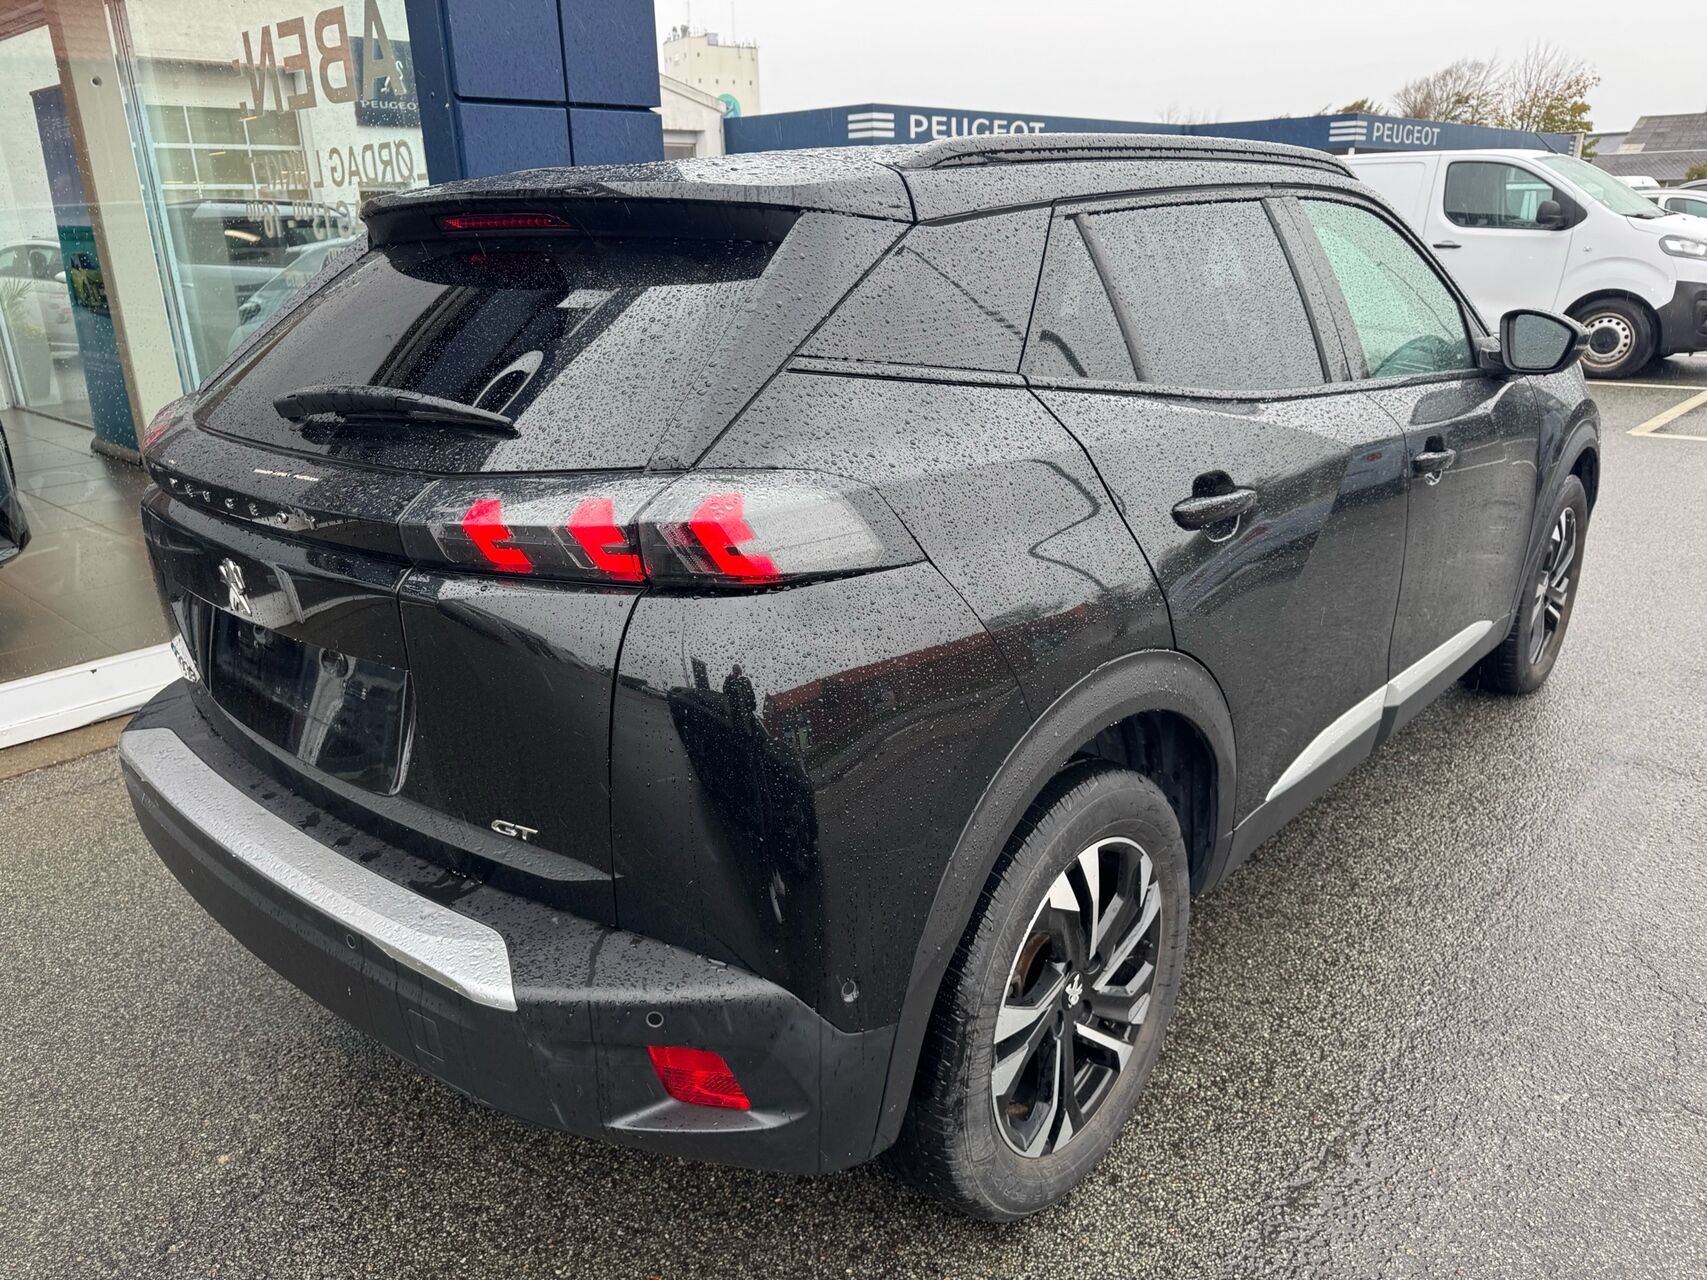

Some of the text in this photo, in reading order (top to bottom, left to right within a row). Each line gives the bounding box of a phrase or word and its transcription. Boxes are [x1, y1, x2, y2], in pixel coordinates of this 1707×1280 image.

[360, 100, 417, 110] PEUGEO
[909, 114, 1045, 139] PEUGEOT
[1372, 122, 1440, 146] PEUGEOT
[491, 819, 539, 841] GT
